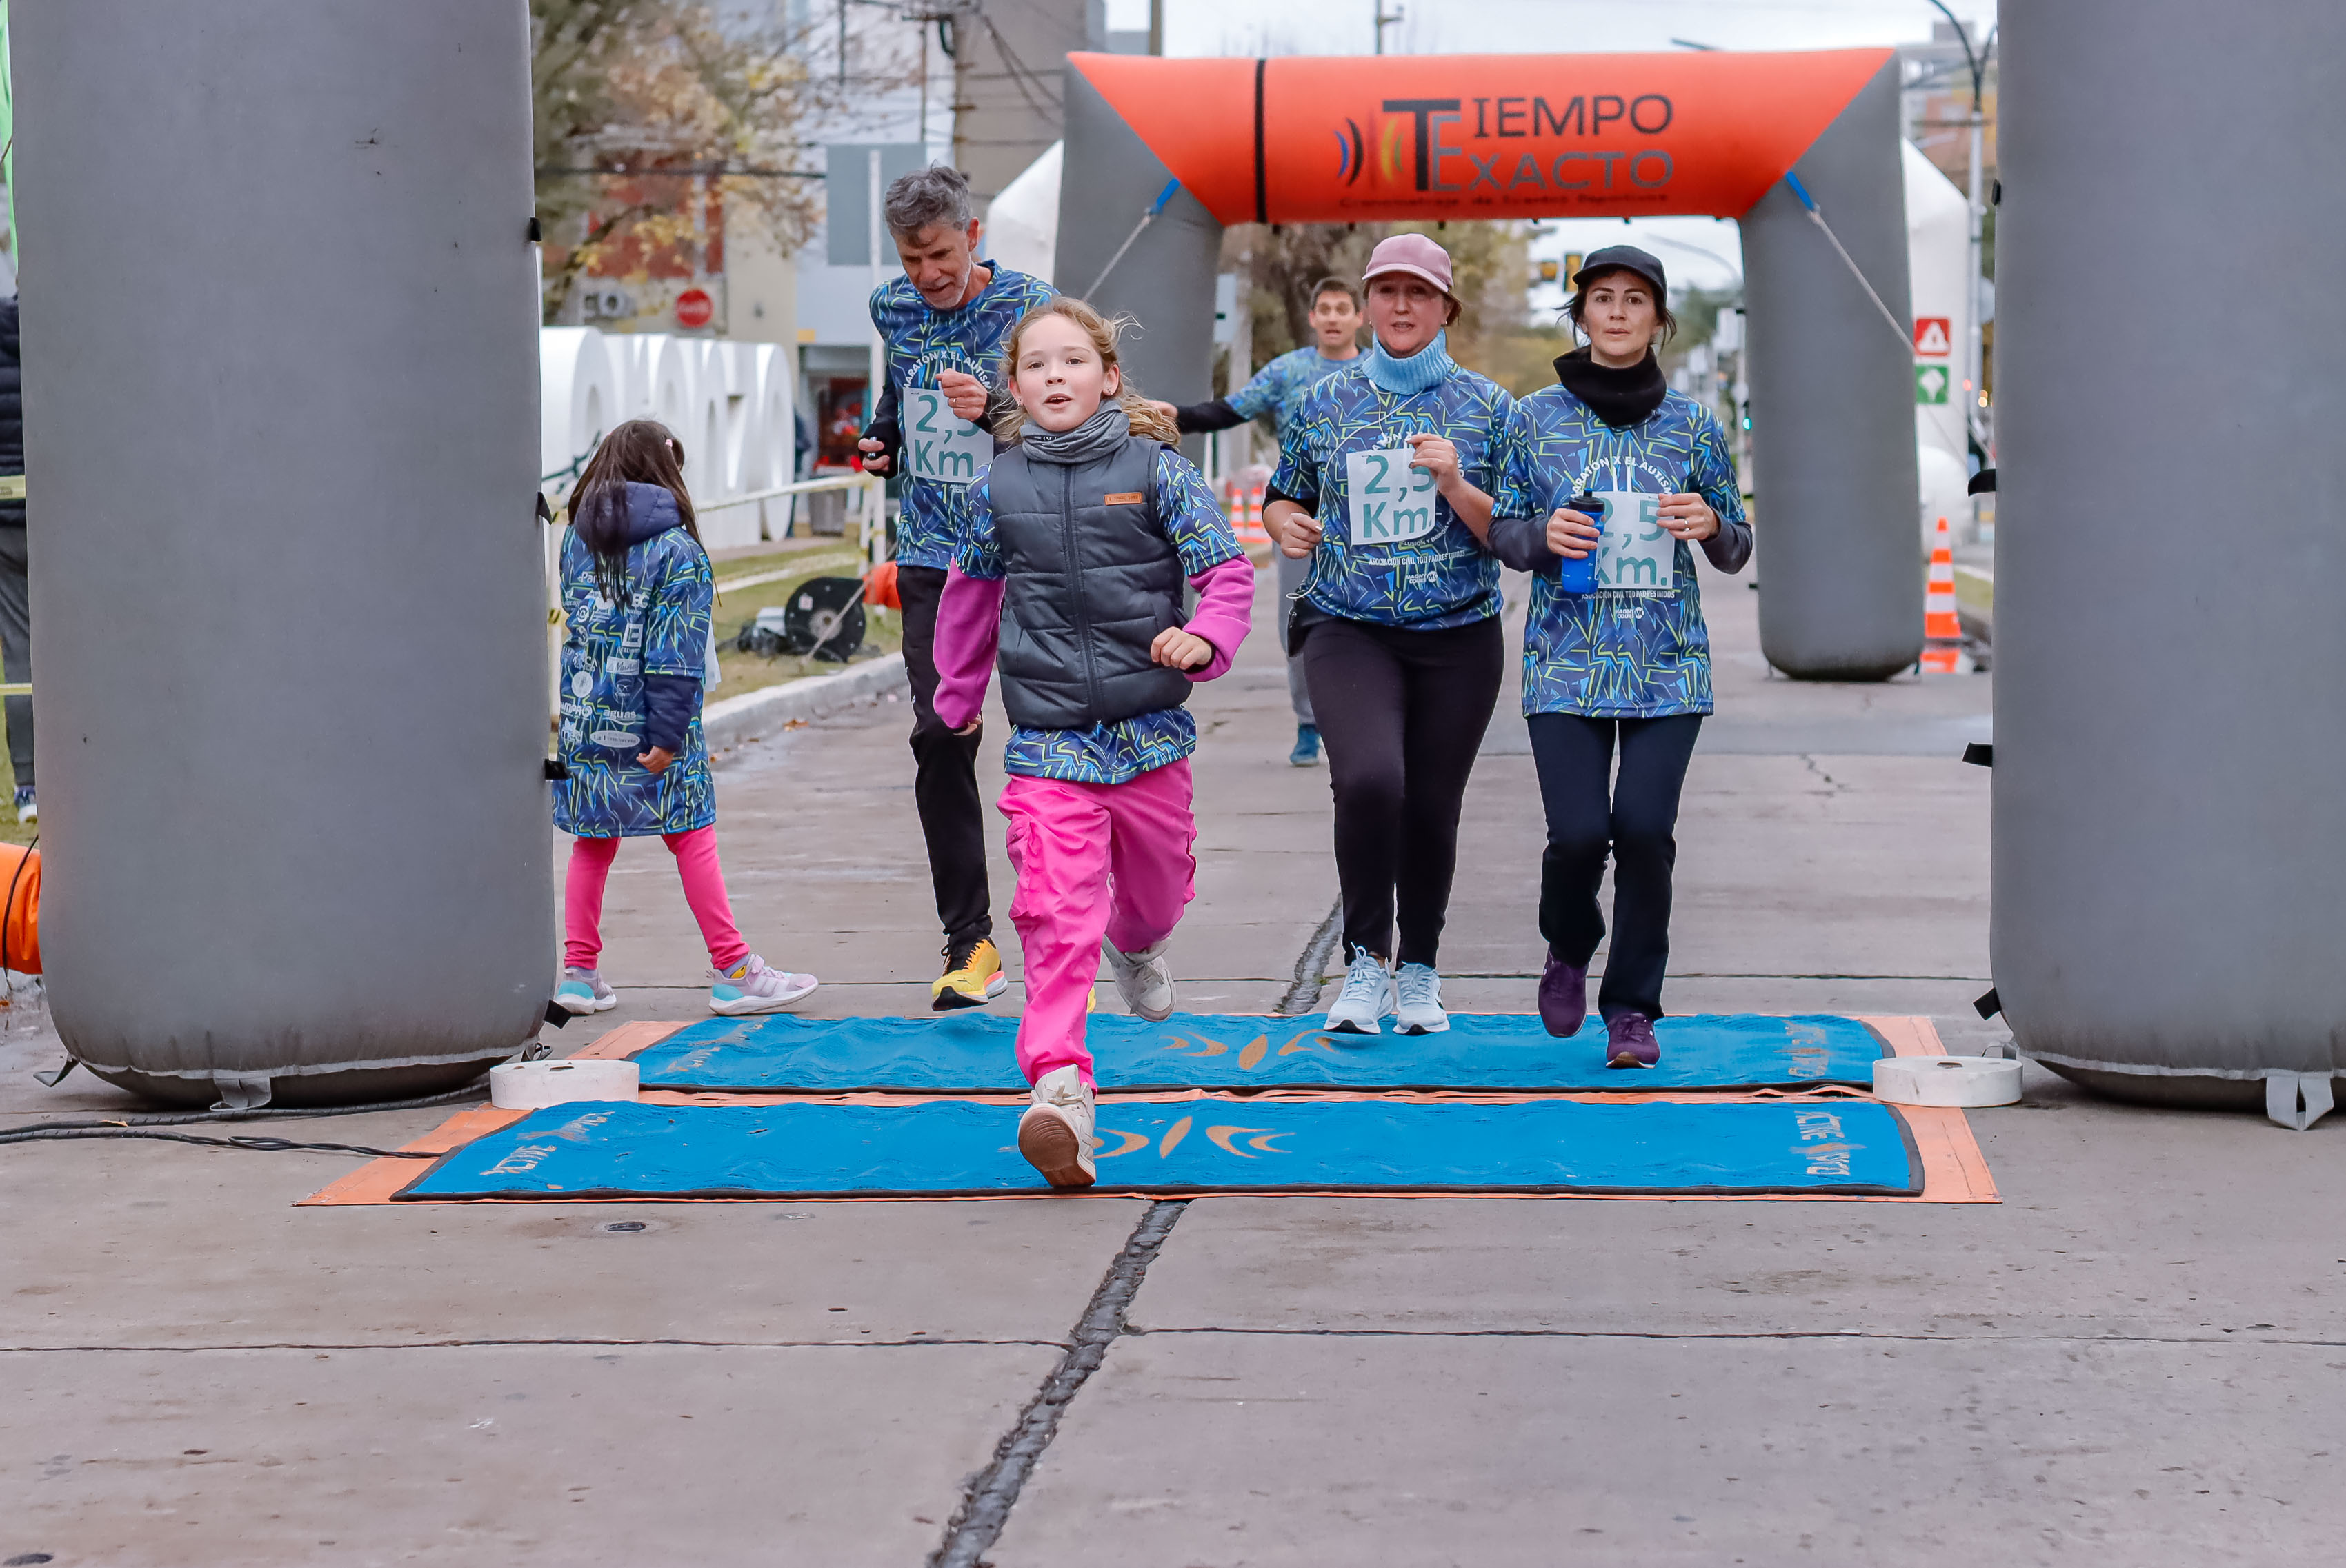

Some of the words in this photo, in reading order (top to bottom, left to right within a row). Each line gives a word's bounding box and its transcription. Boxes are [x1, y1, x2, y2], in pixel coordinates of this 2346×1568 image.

[1431, 113, 1675, 192] EXACTO
[951, 351, 962, 362] EL
[964, 357, 992, 390] AUTISM
[1613, 456, 1621, 464] X
[1624, 456, 1637, 466] EL
[1639, 461, 1673, 495] AUTISM
[1402, 557, 1416, 565] CIVIL
[1428, 553, 1448, 563] PADRES
